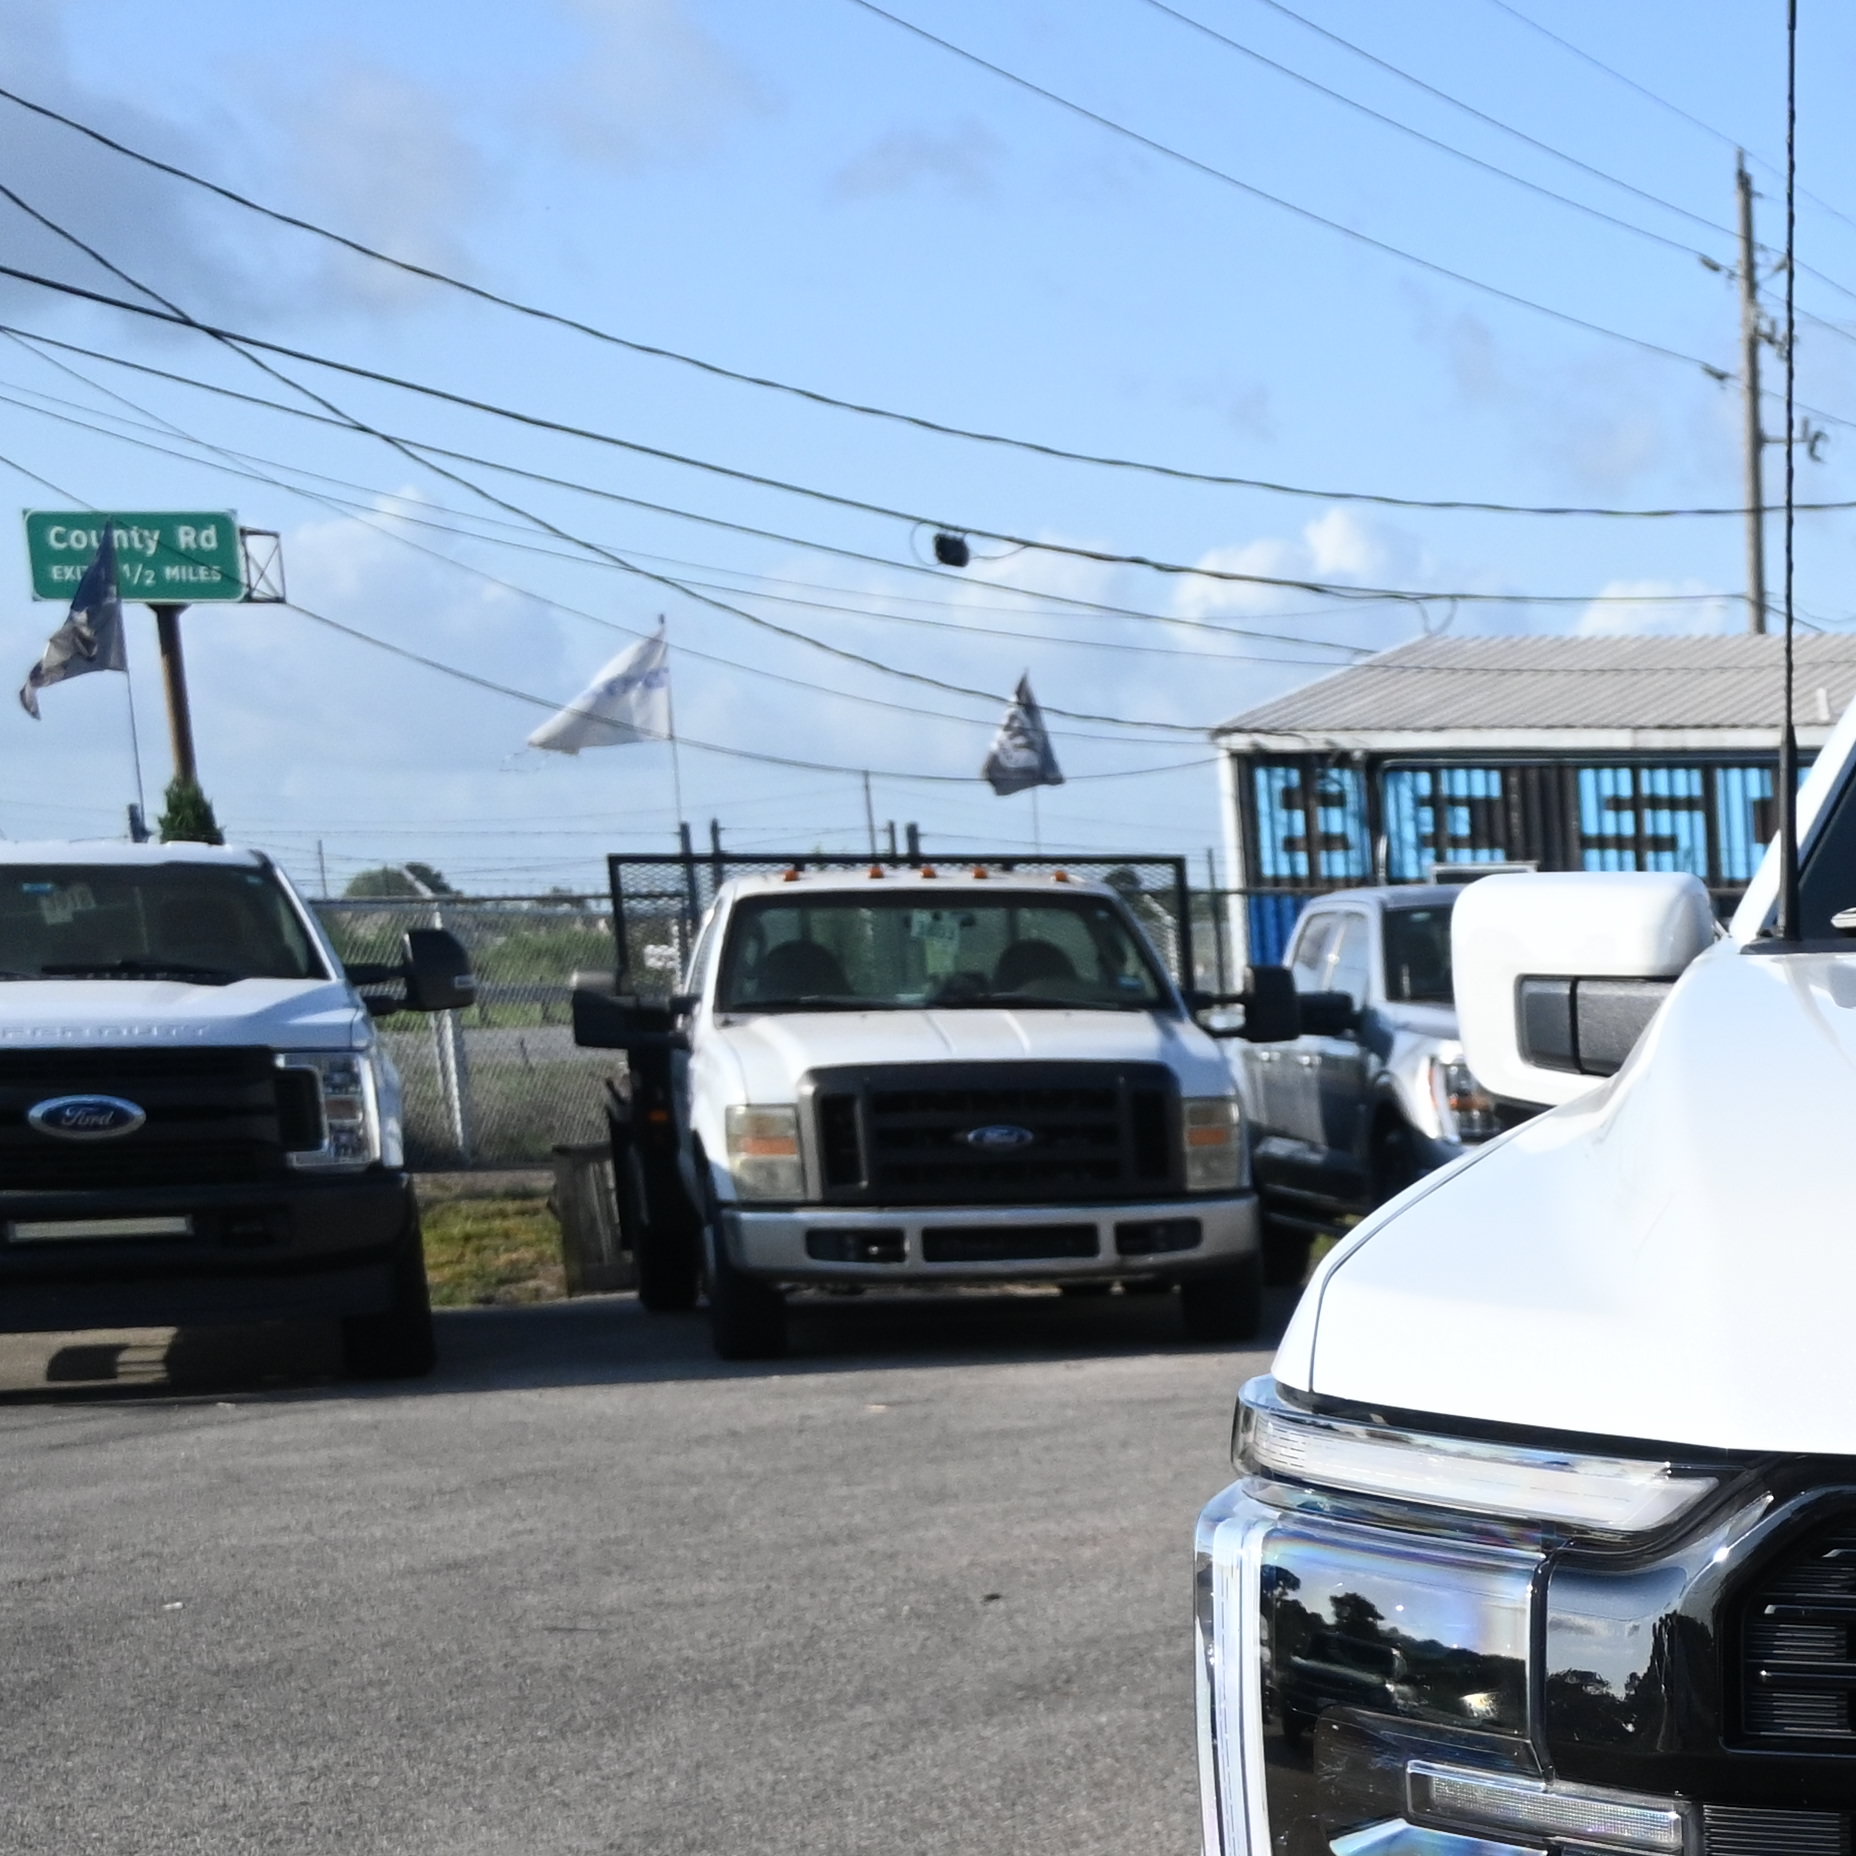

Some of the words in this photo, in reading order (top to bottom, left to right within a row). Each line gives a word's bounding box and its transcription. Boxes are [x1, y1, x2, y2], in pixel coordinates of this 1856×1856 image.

[177, 524, 219, 549] Rd
[164, 565, 222, 582] MILES
[60, 1105, 115, 1126] Ford
